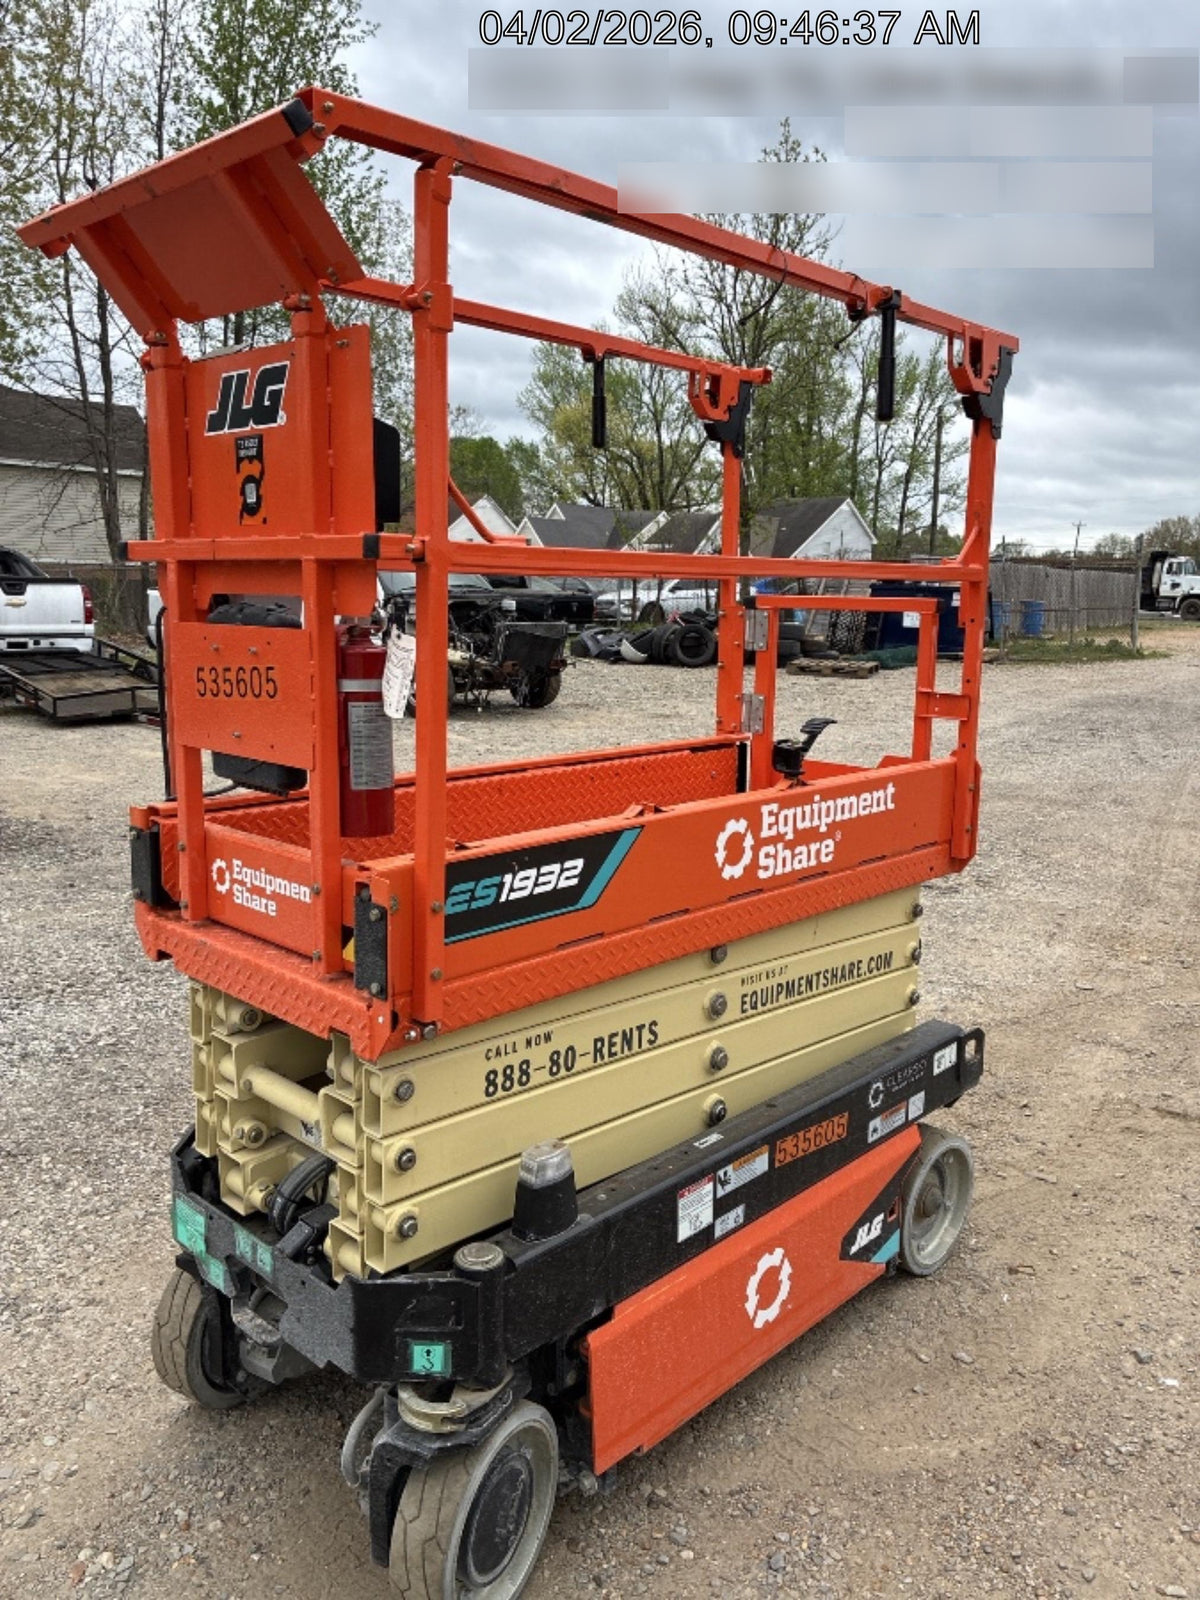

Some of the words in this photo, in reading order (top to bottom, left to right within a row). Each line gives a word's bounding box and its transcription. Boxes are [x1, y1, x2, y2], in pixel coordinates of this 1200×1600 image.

[204, 361, 290, 435] JLG
[196, 666, 278, 699] 535605
[759, 782, 896, 841] Equipment
[231, 858, 312, 904] Equipmen
[757, 837, 835, 880] Share
[232, 882, 277, 917] Share
[445, 858, 584, 915] ES1932
[740, 951, 893, 1014] EQUIPMENTSHARE.COM
[484, 1020, 659, 1098] 888-80-RENTS
[485, 1040, 518, 1061] CALL
[525, 1030, 554, 1050] NOW
[777, 1113, 847, 1164] 535605
[849, 1212, 884, 1256] JLG
